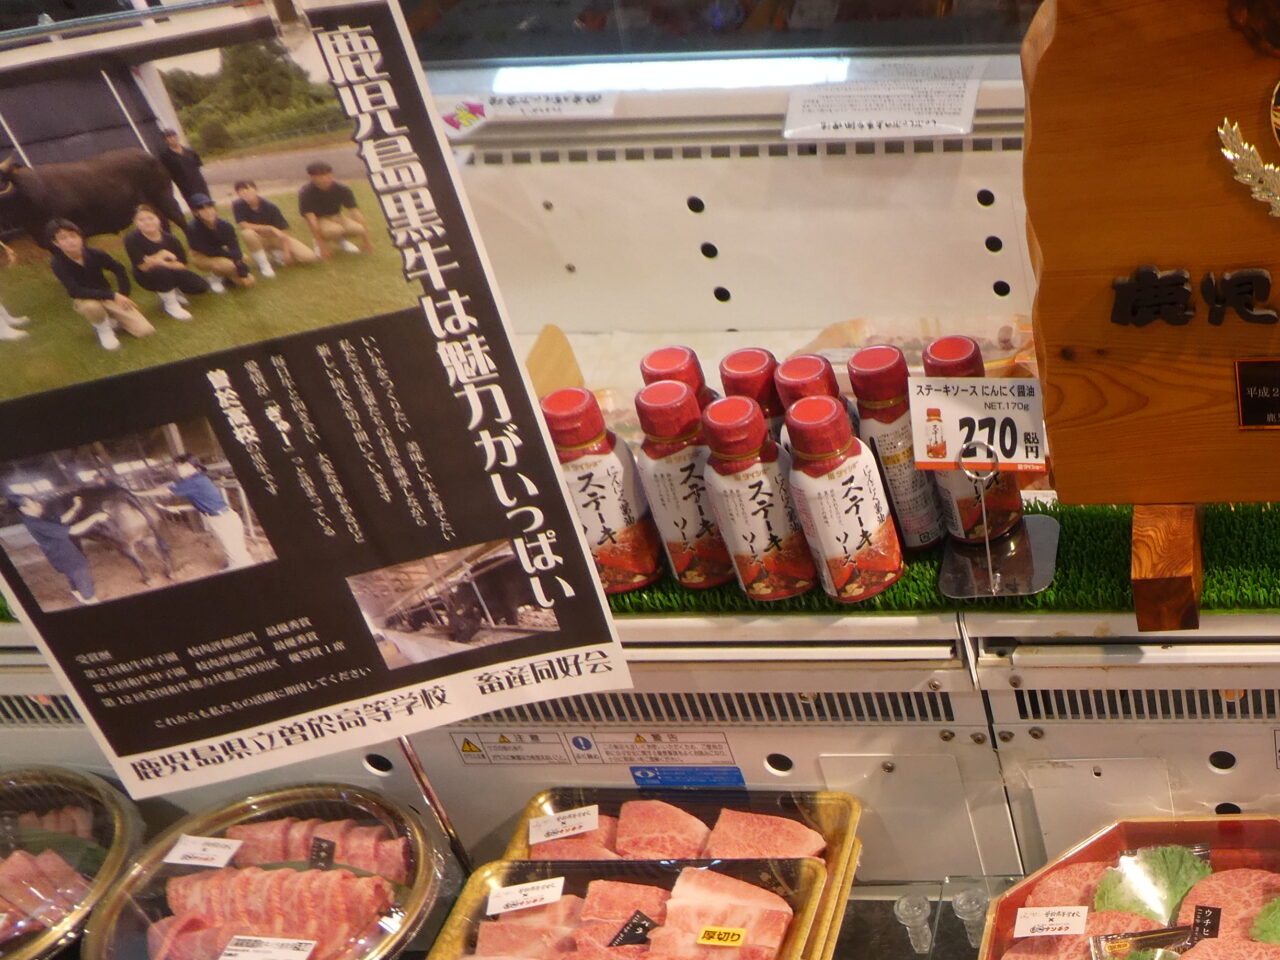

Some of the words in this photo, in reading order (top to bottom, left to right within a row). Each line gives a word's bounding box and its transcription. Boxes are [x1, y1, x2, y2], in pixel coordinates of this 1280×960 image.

[312, 24, 577, 608] 鹿児島黒牛は魅力がいっぱい
[916, 385, 978, 397] ステーキソース
[981, 384, 1035, 398] にんにく醤油
[959, 416, 1018, 459] 270
[1025, 445, 1039, 459] 円
[577, 472, 617, 546] ステーキ
[680, 463, 715, 539] ステーキ
[749, 480, 783, 553] ステーキ
[842, 475, 873, 551] ステーキ
[673, 517, 697, 552] ソース
[742, 531, 766, 565] ソース
[836, 531, 858, 567] ソース
[130, 684, 451, 782] 鹿児島県立曽於高等学校
[474, 649, 614, 696] 畜産同好会
[701, 930, 741, 942] 厚切り
